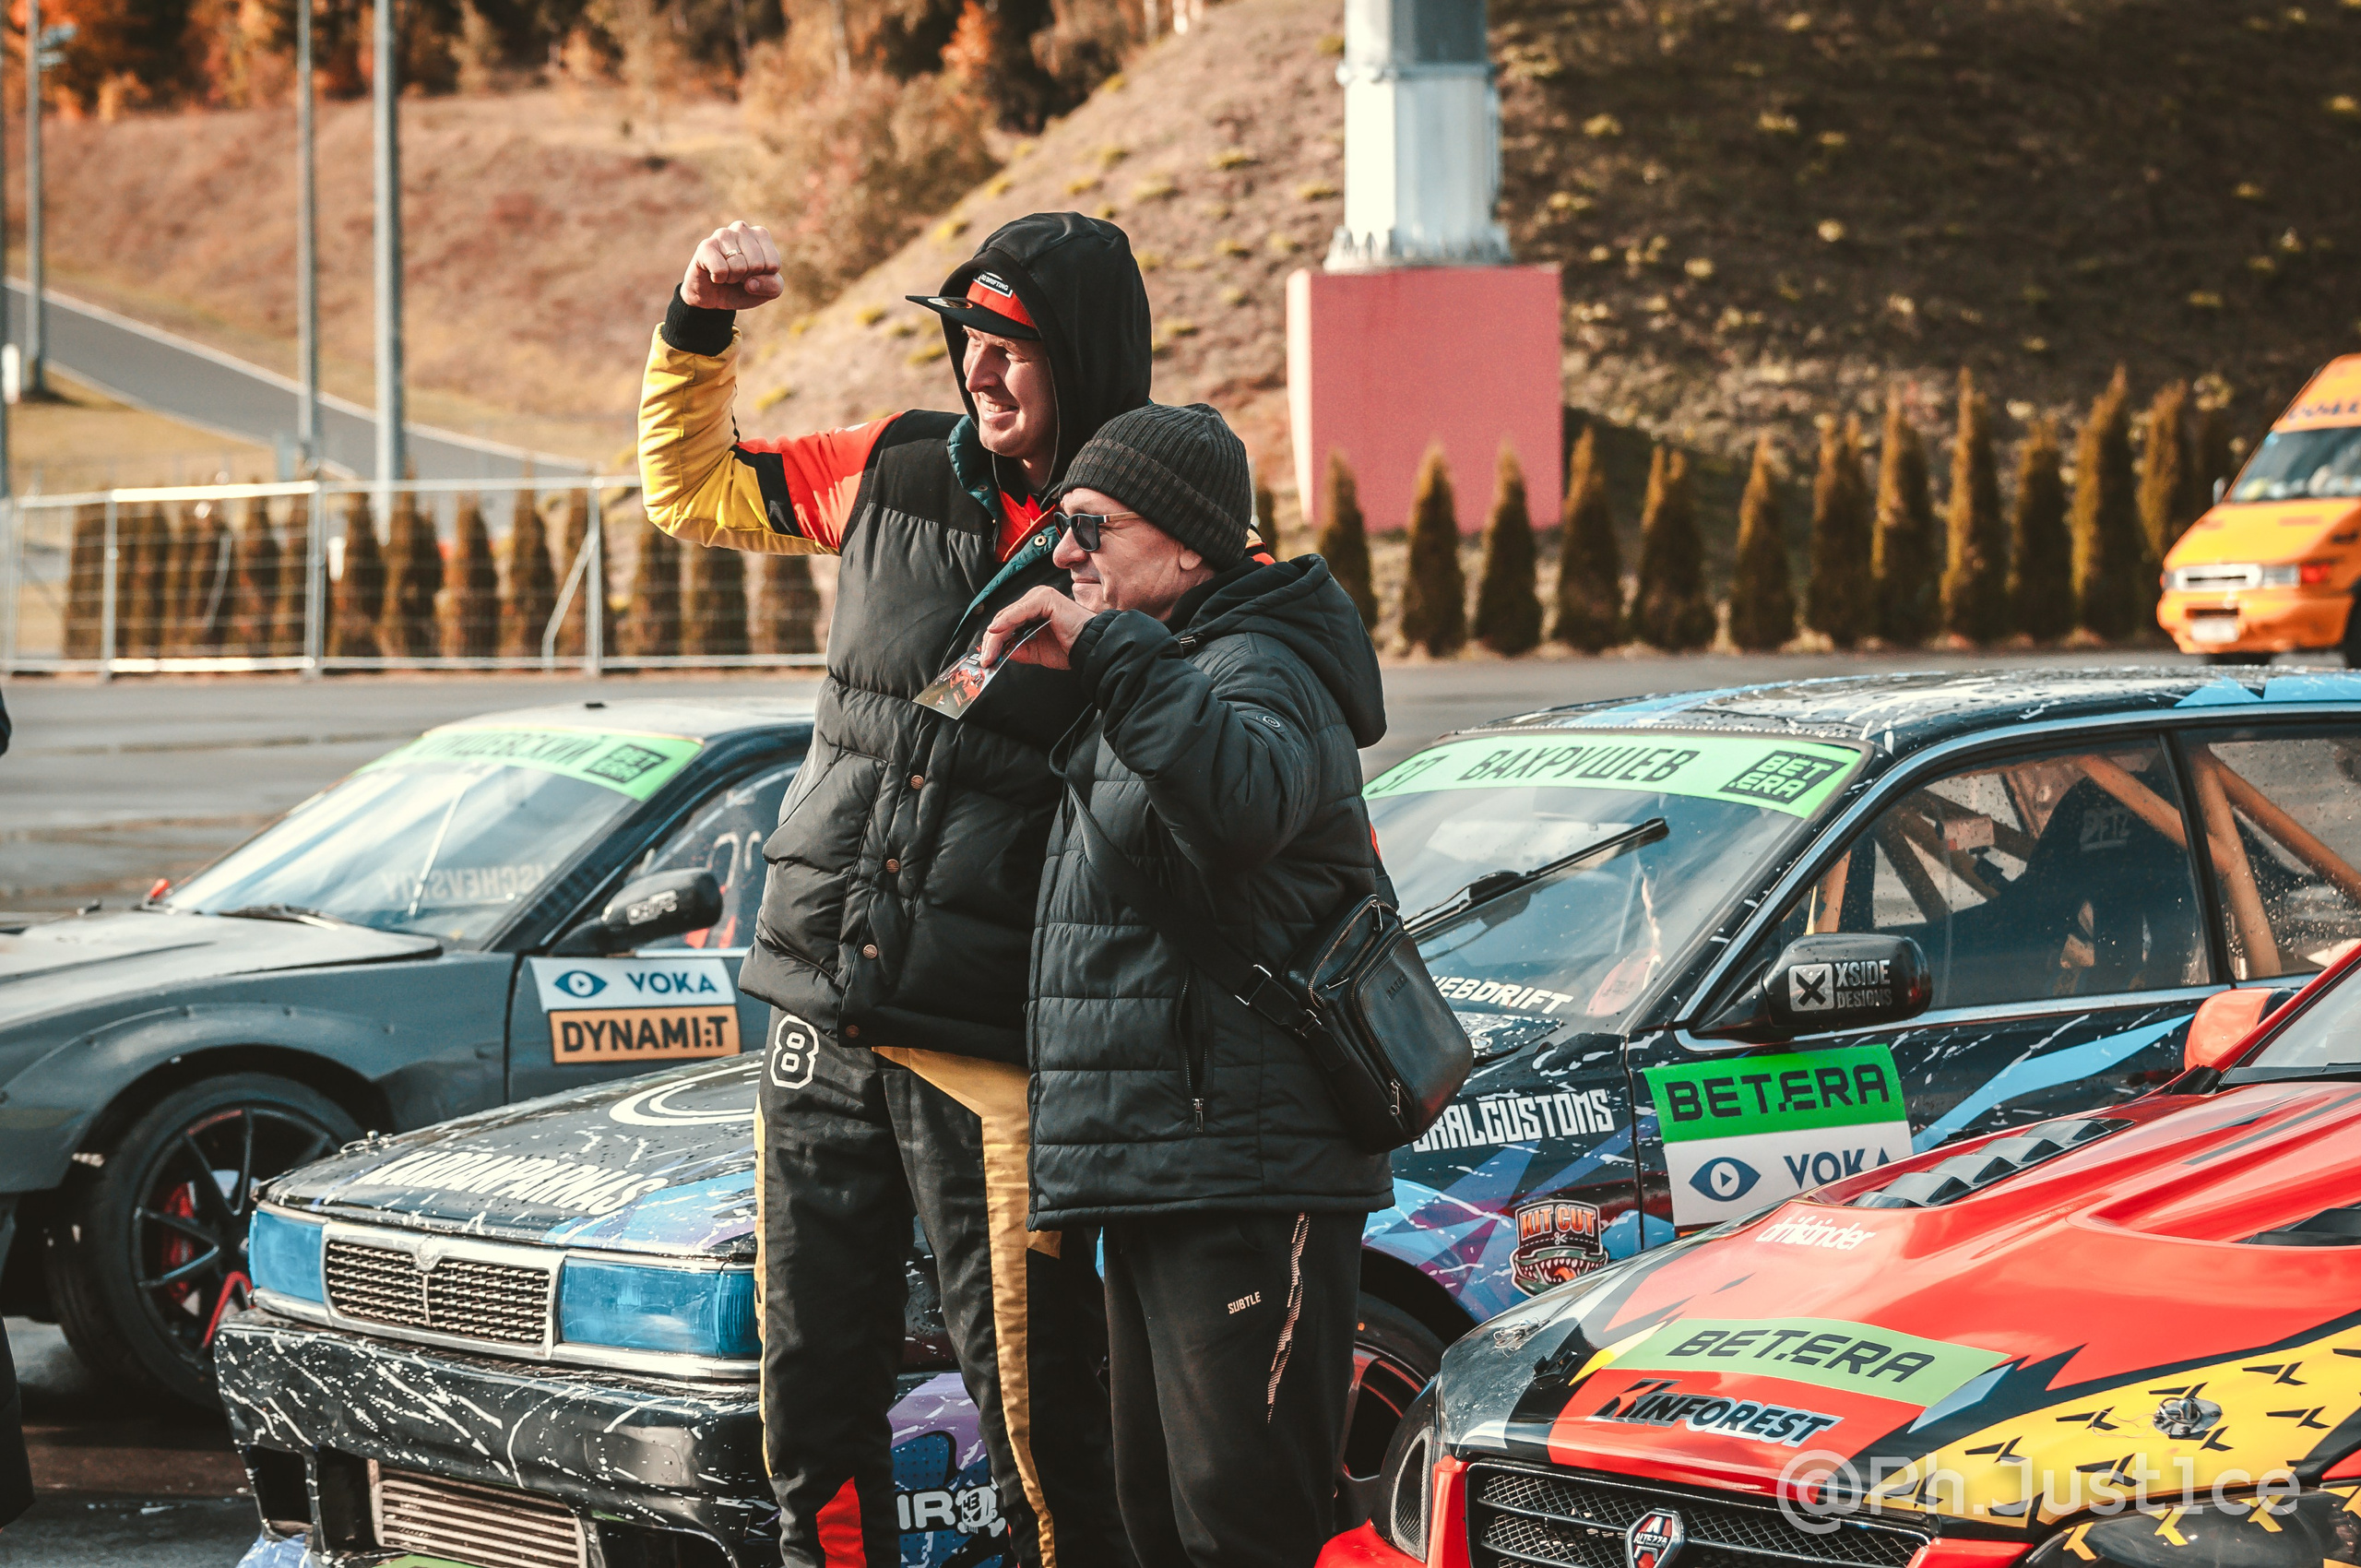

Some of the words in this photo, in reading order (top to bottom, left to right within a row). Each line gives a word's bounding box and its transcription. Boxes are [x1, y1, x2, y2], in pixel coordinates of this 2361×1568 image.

[1458, 746, 1700, 782] ВАХРУШЕВ
[1756, 754, 1833, 780] BET
[626, 972, 718, 993] VOKA
[1834, 959, 1891, 987] XSIDE
[1836, 988, 1892, 1009] DESIGNS
[771, 1014, 819, 1090] 8
[1519, 1205, 1553, 1241] KIT
[1555, 1204, 1596, 1237] CUT
[1228, 1291, 1262, 1314] SUBTLE
[963, 1491, 980, 1511] 43
